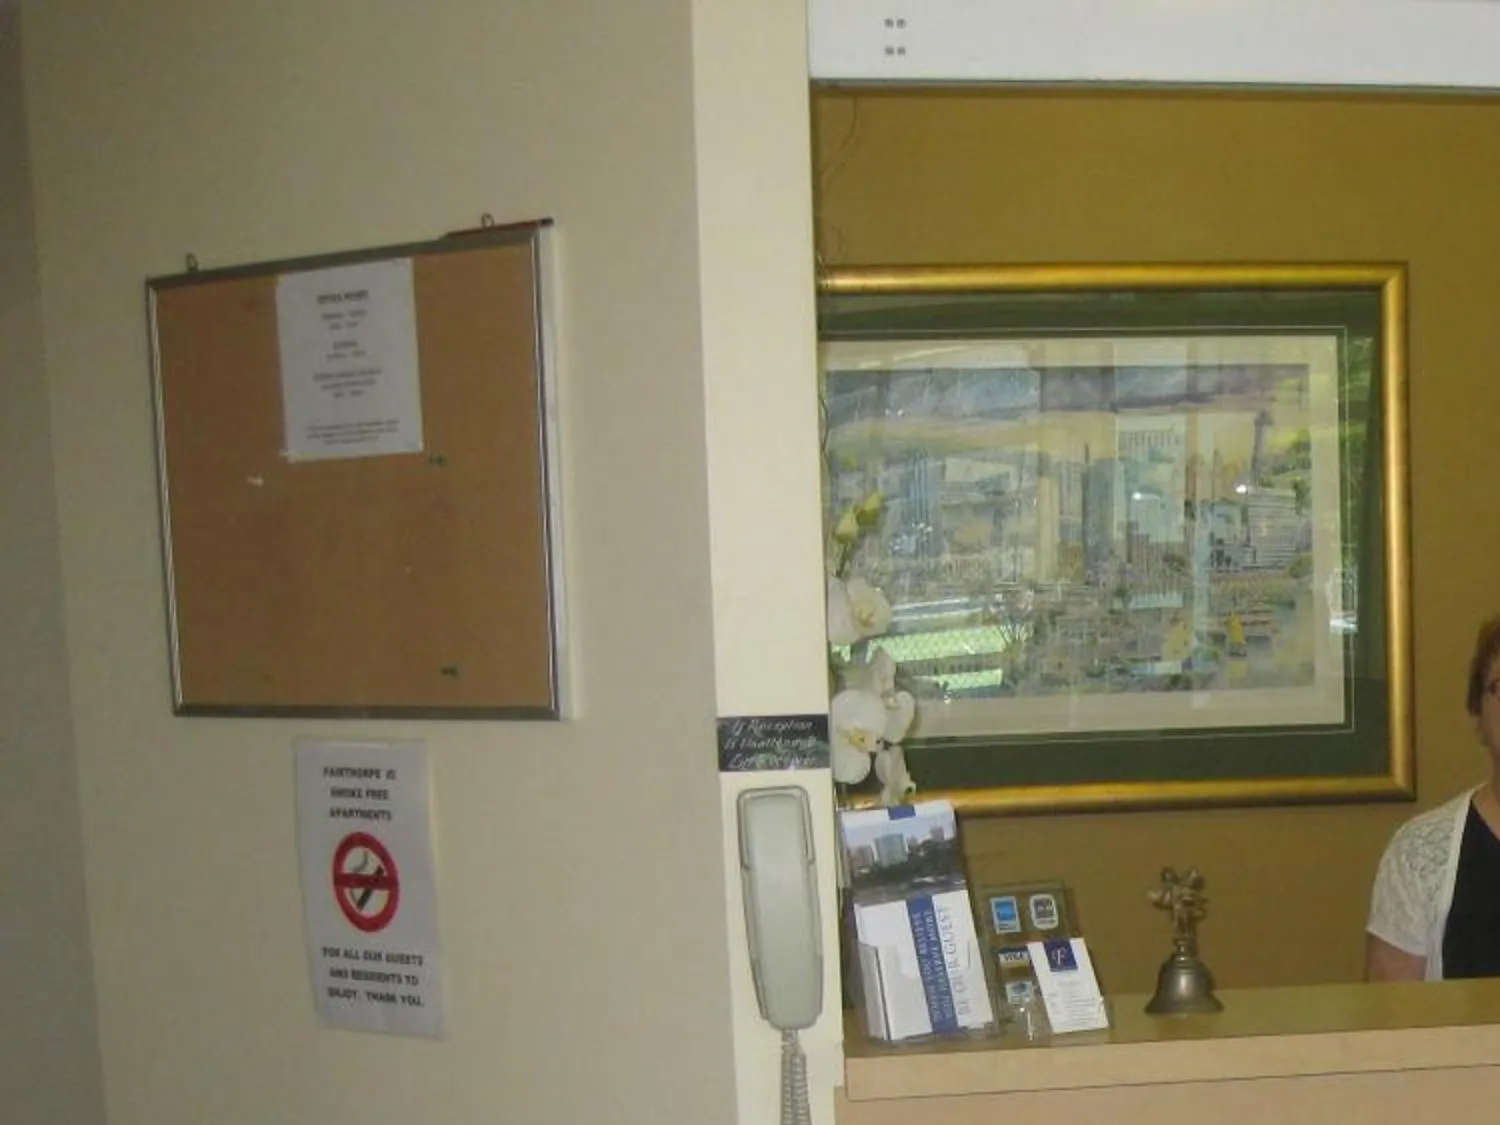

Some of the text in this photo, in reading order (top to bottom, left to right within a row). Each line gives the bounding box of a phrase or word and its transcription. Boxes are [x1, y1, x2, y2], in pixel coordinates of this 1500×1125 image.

[365, 788, 390, 801] FREE
[329, 807, 393, 822] APARTMENTS
[321, 945, 340, 958] FOR
[343, 947, 361, 961] ALL
[405, 975, 420, 987] TO
